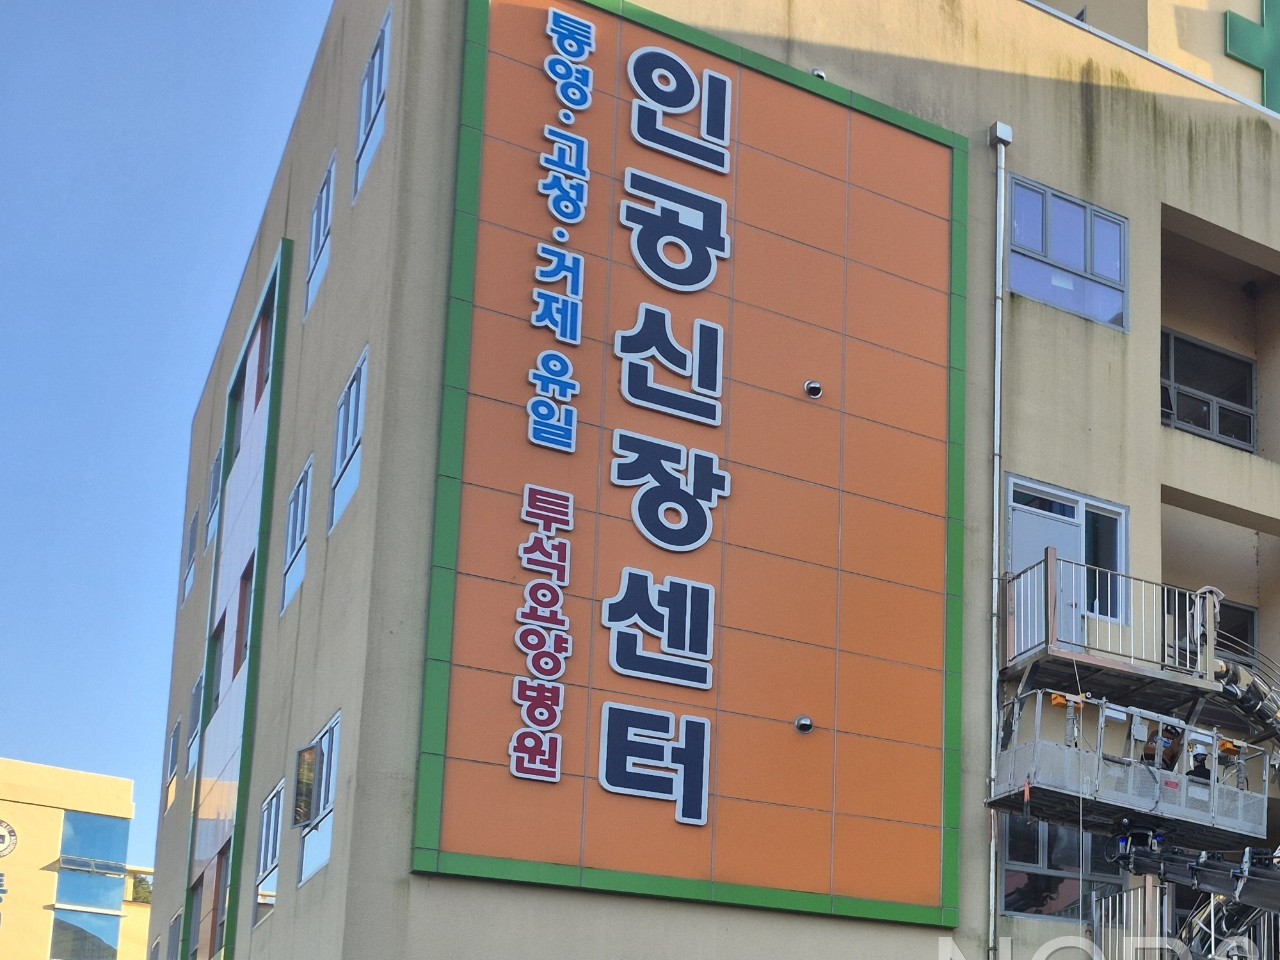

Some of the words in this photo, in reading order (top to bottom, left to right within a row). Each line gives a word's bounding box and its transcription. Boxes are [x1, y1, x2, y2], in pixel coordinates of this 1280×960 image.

[526, 349, 582, 454] 유일
[598, 44, 733, 826] 인공신장센터
[508, 483, 575, 784] 투석요양병원
